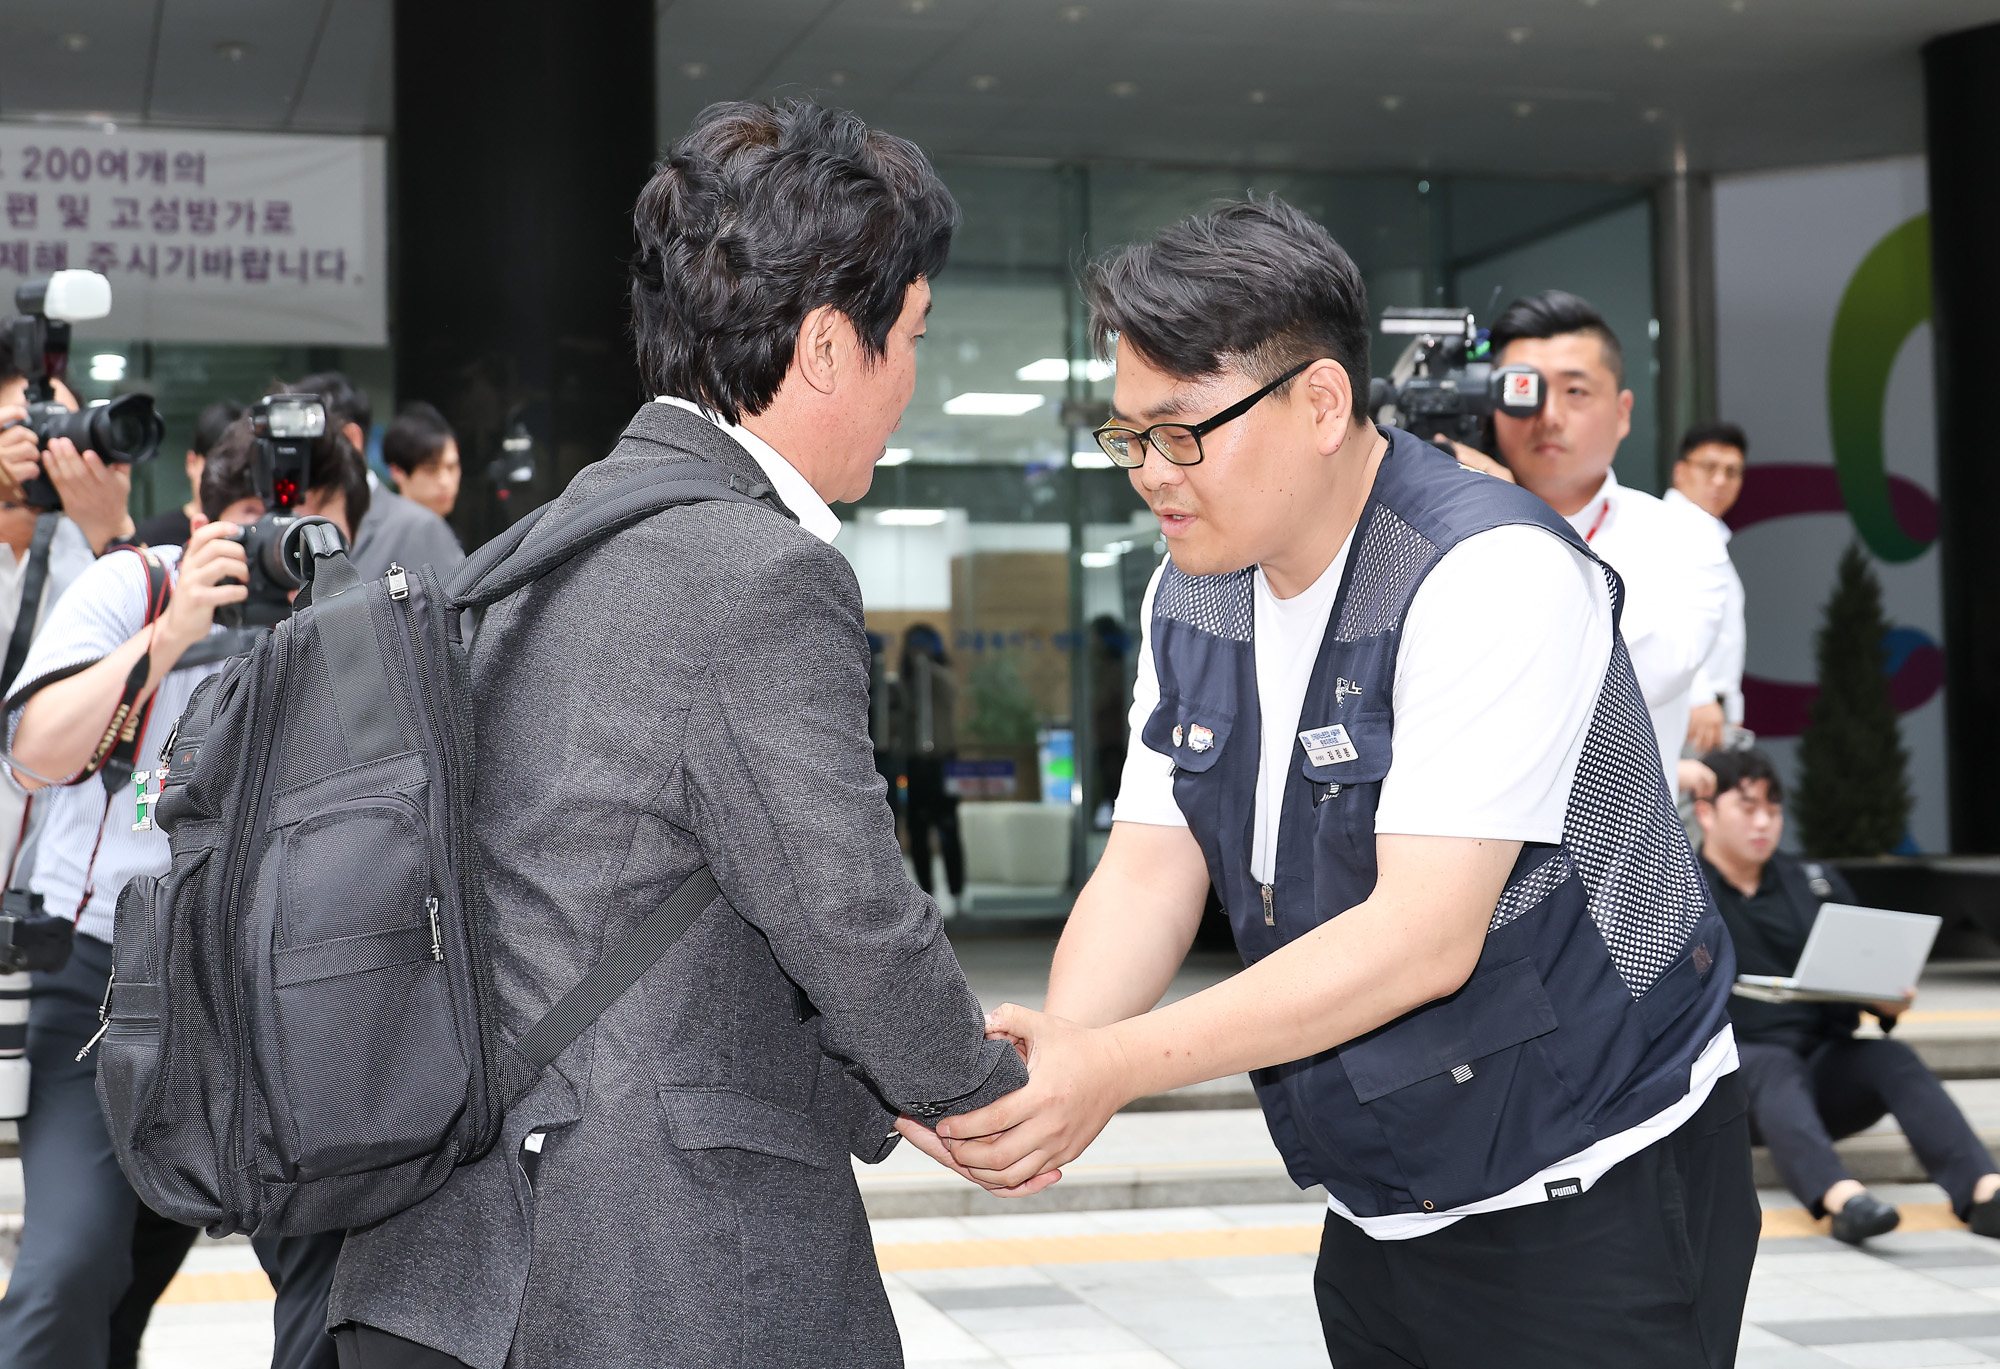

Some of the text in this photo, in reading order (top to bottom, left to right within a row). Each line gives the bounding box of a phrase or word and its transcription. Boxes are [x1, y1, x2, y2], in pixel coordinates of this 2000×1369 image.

[23, 145, 206, 187] 200여개의
[6, 192, 294, 235] 편 및 고성방가로
[87, 241, 363, 285] 주시기바랍니다.
[1550, 1184, 1578, 1198] PUMA
